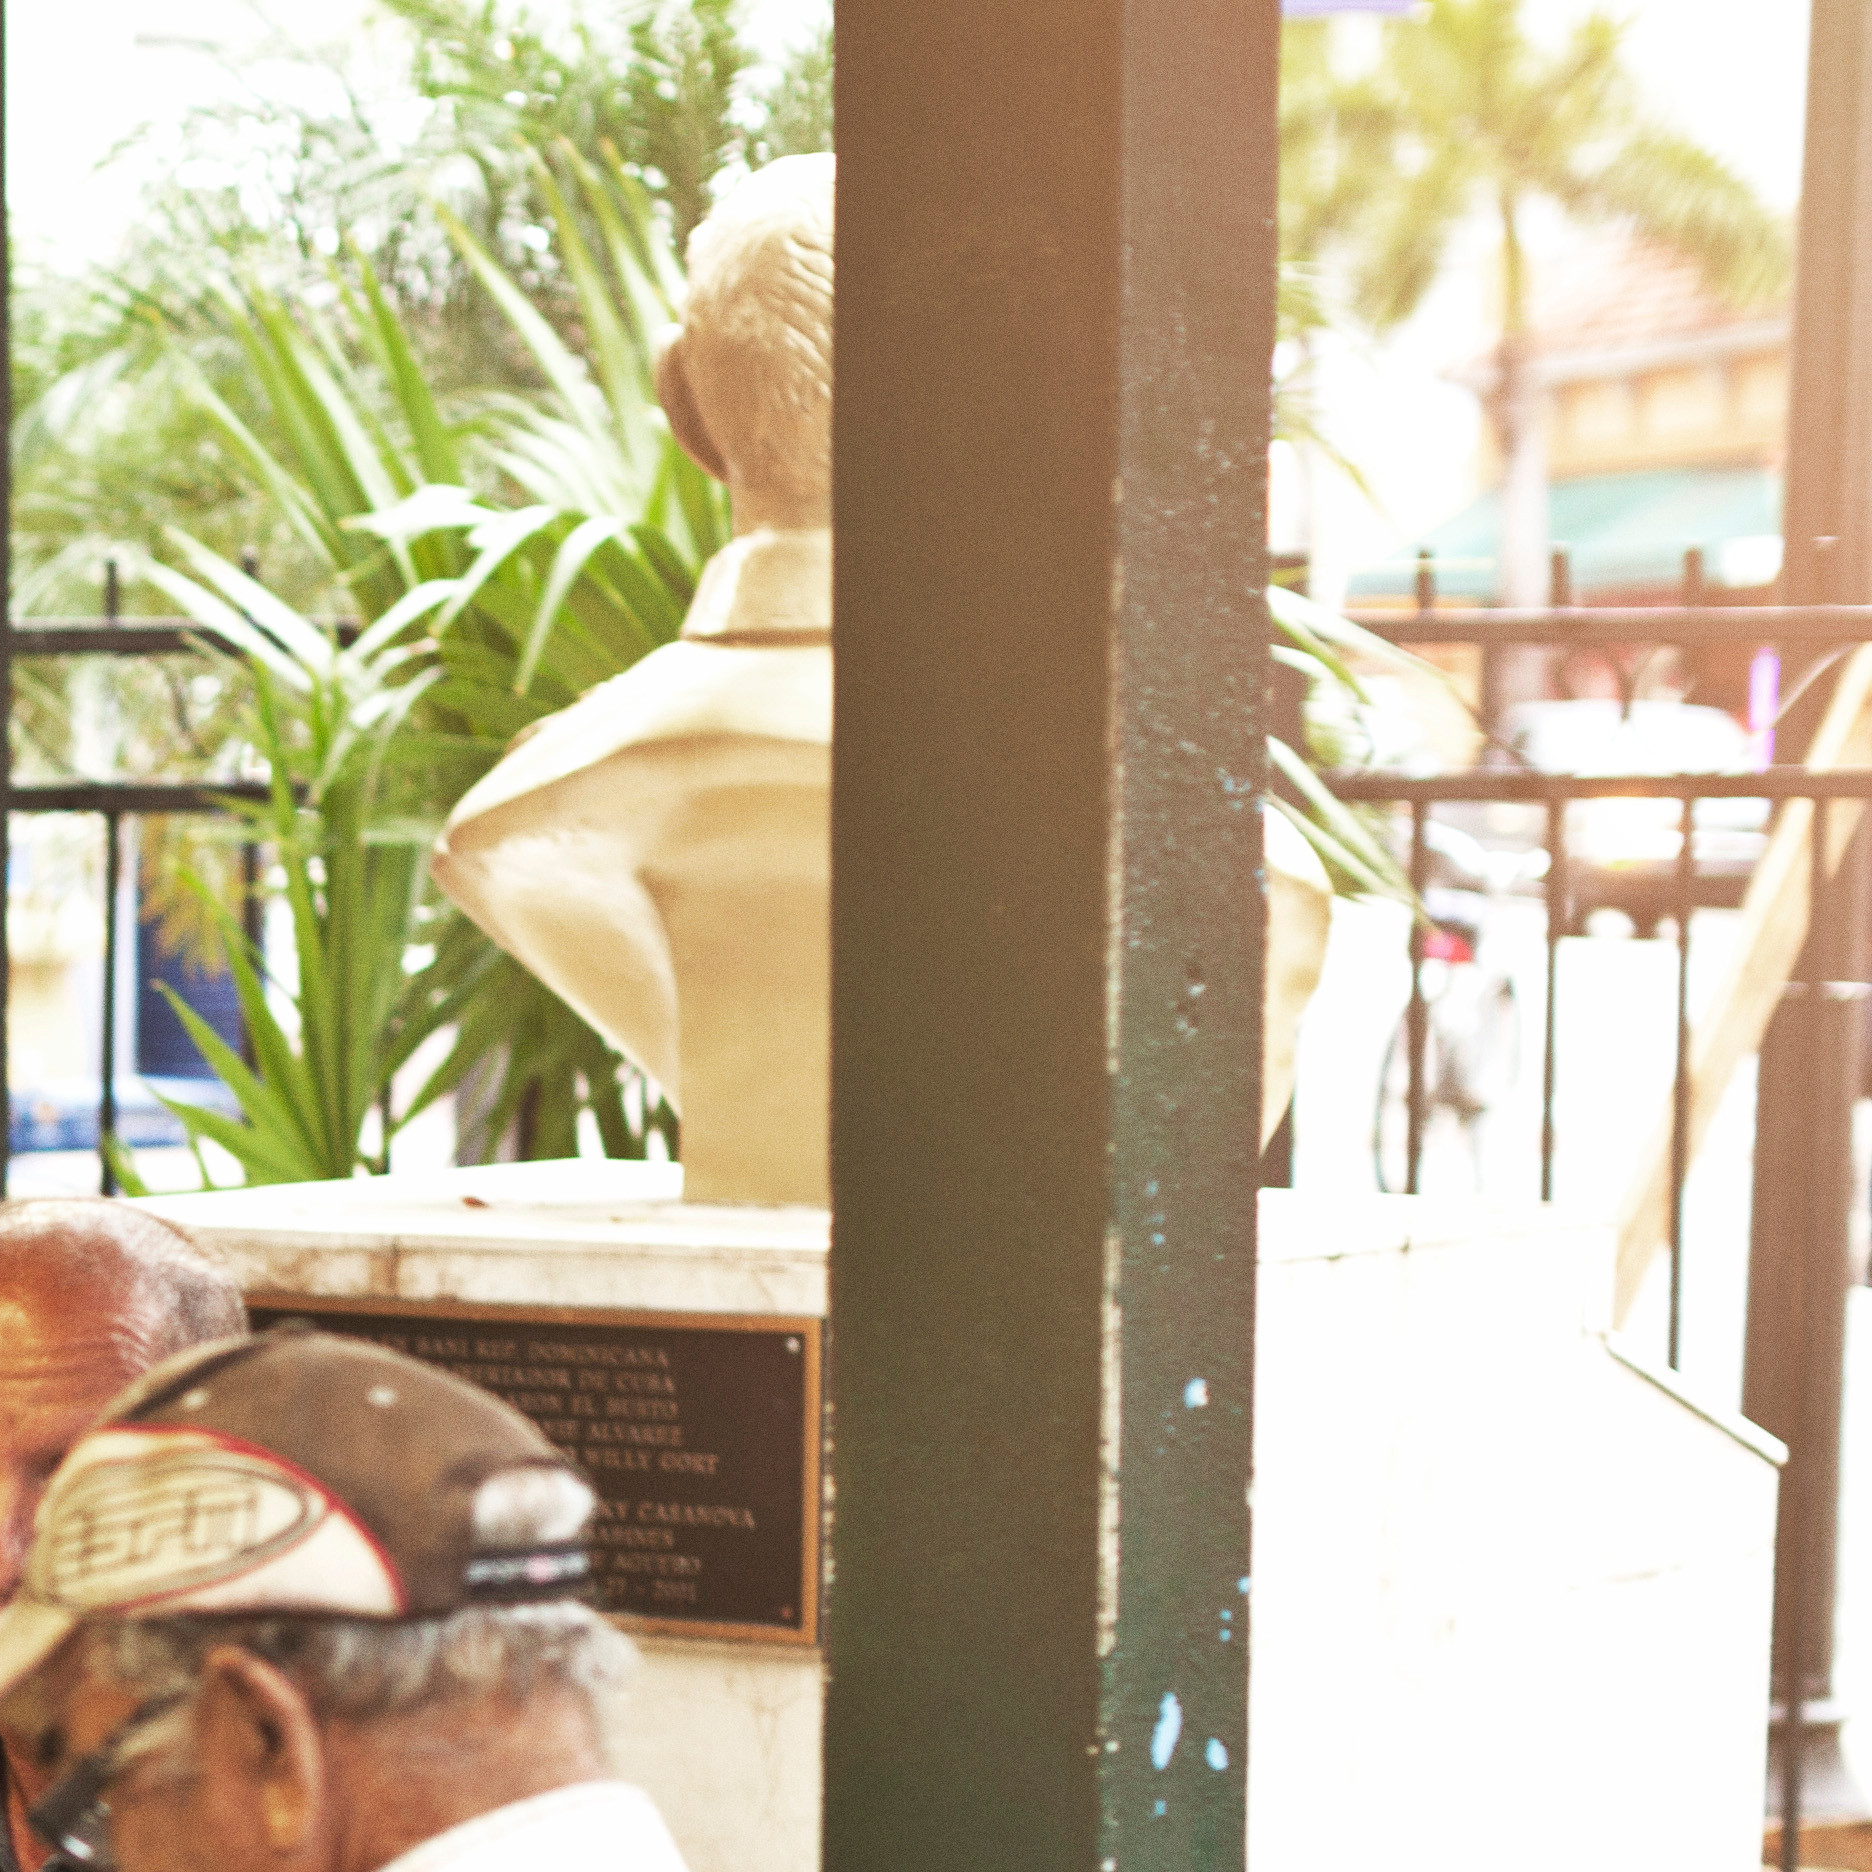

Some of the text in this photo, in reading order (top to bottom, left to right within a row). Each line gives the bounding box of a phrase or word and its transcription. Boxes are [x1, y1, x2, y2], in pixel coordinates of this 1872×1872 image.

[528, 1341, 671, 1368] DOMINICANA
[578, 1369, 609, 1391] DE
[614, 1371, 677, 1394] CUBA
[605, 1396, 680, 1420] BUSTO
[587, 1423, 685, 1447] ALVAREZ
[583, 1446, 651, 1472] WILLY
[635, 1501, 756, 1529] CASANOVA
